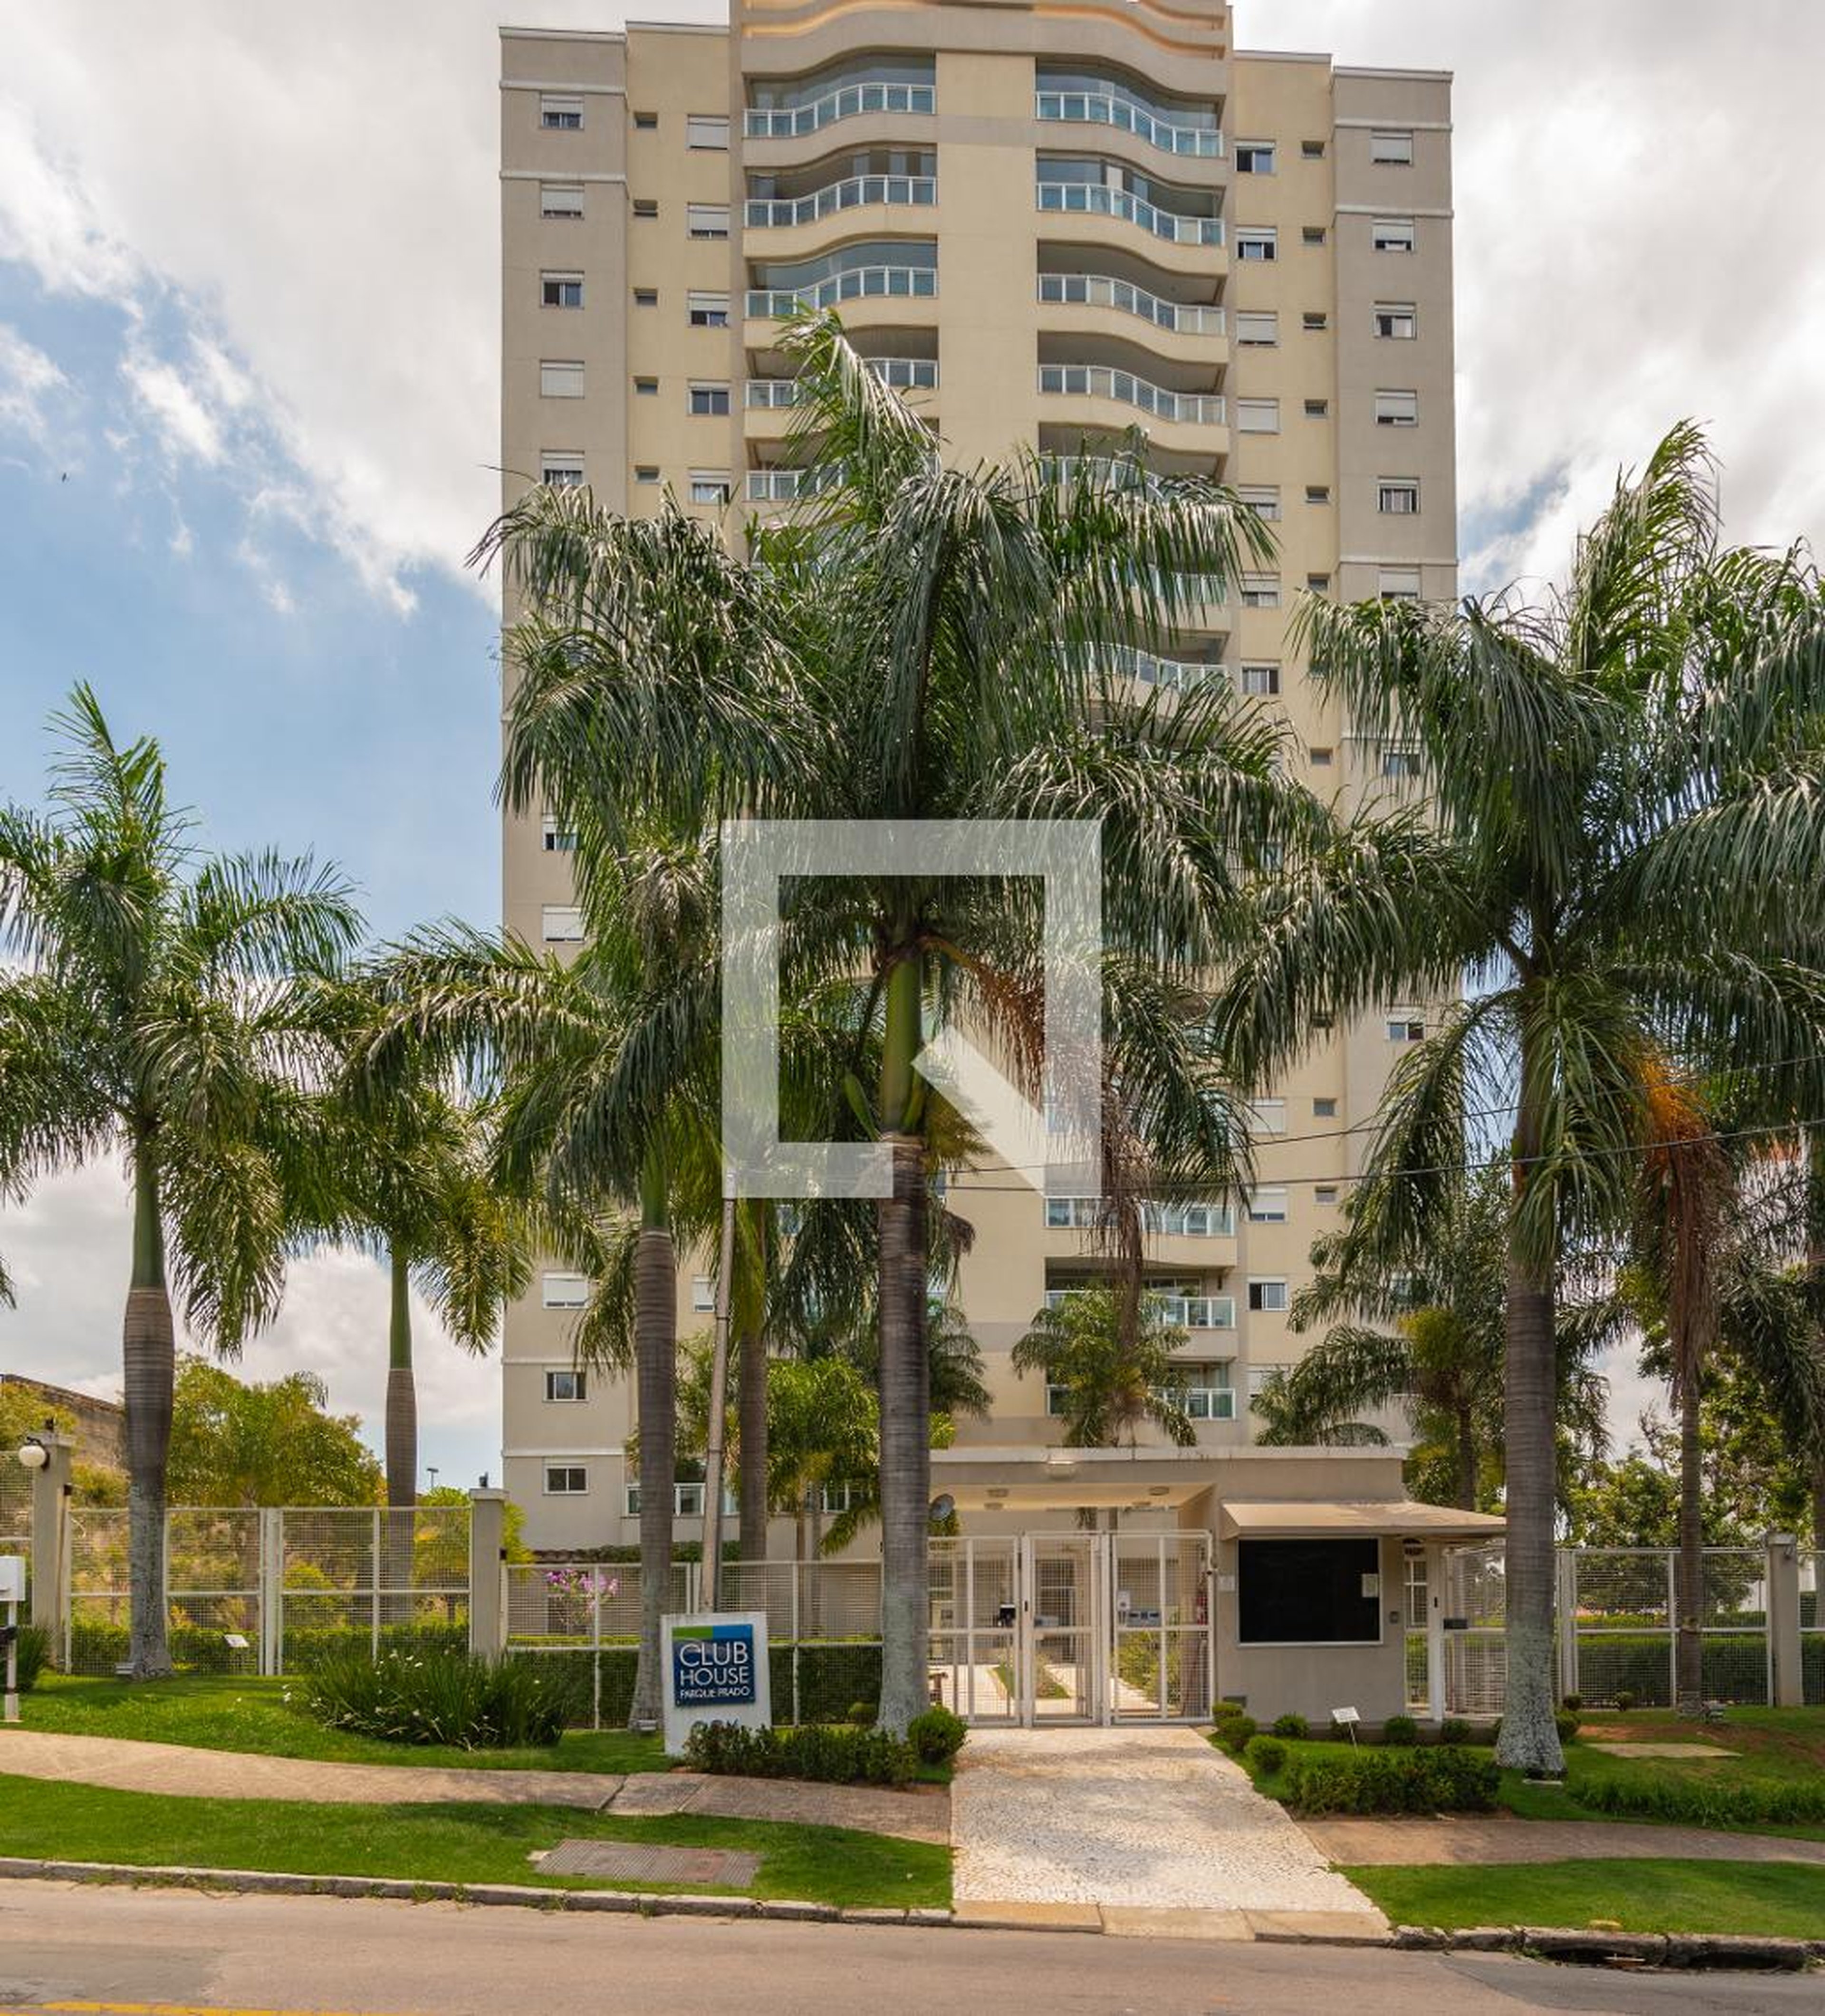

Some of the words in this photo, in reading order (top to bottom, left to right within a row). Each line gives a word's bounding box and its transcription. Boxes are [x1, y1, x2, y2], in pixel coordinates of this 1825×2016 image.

[680, 1641, 749, 1667] CLUB
[680, 1666, 749, 1686] HOUSE
[717, 1686, 750, 1697] PRADO
